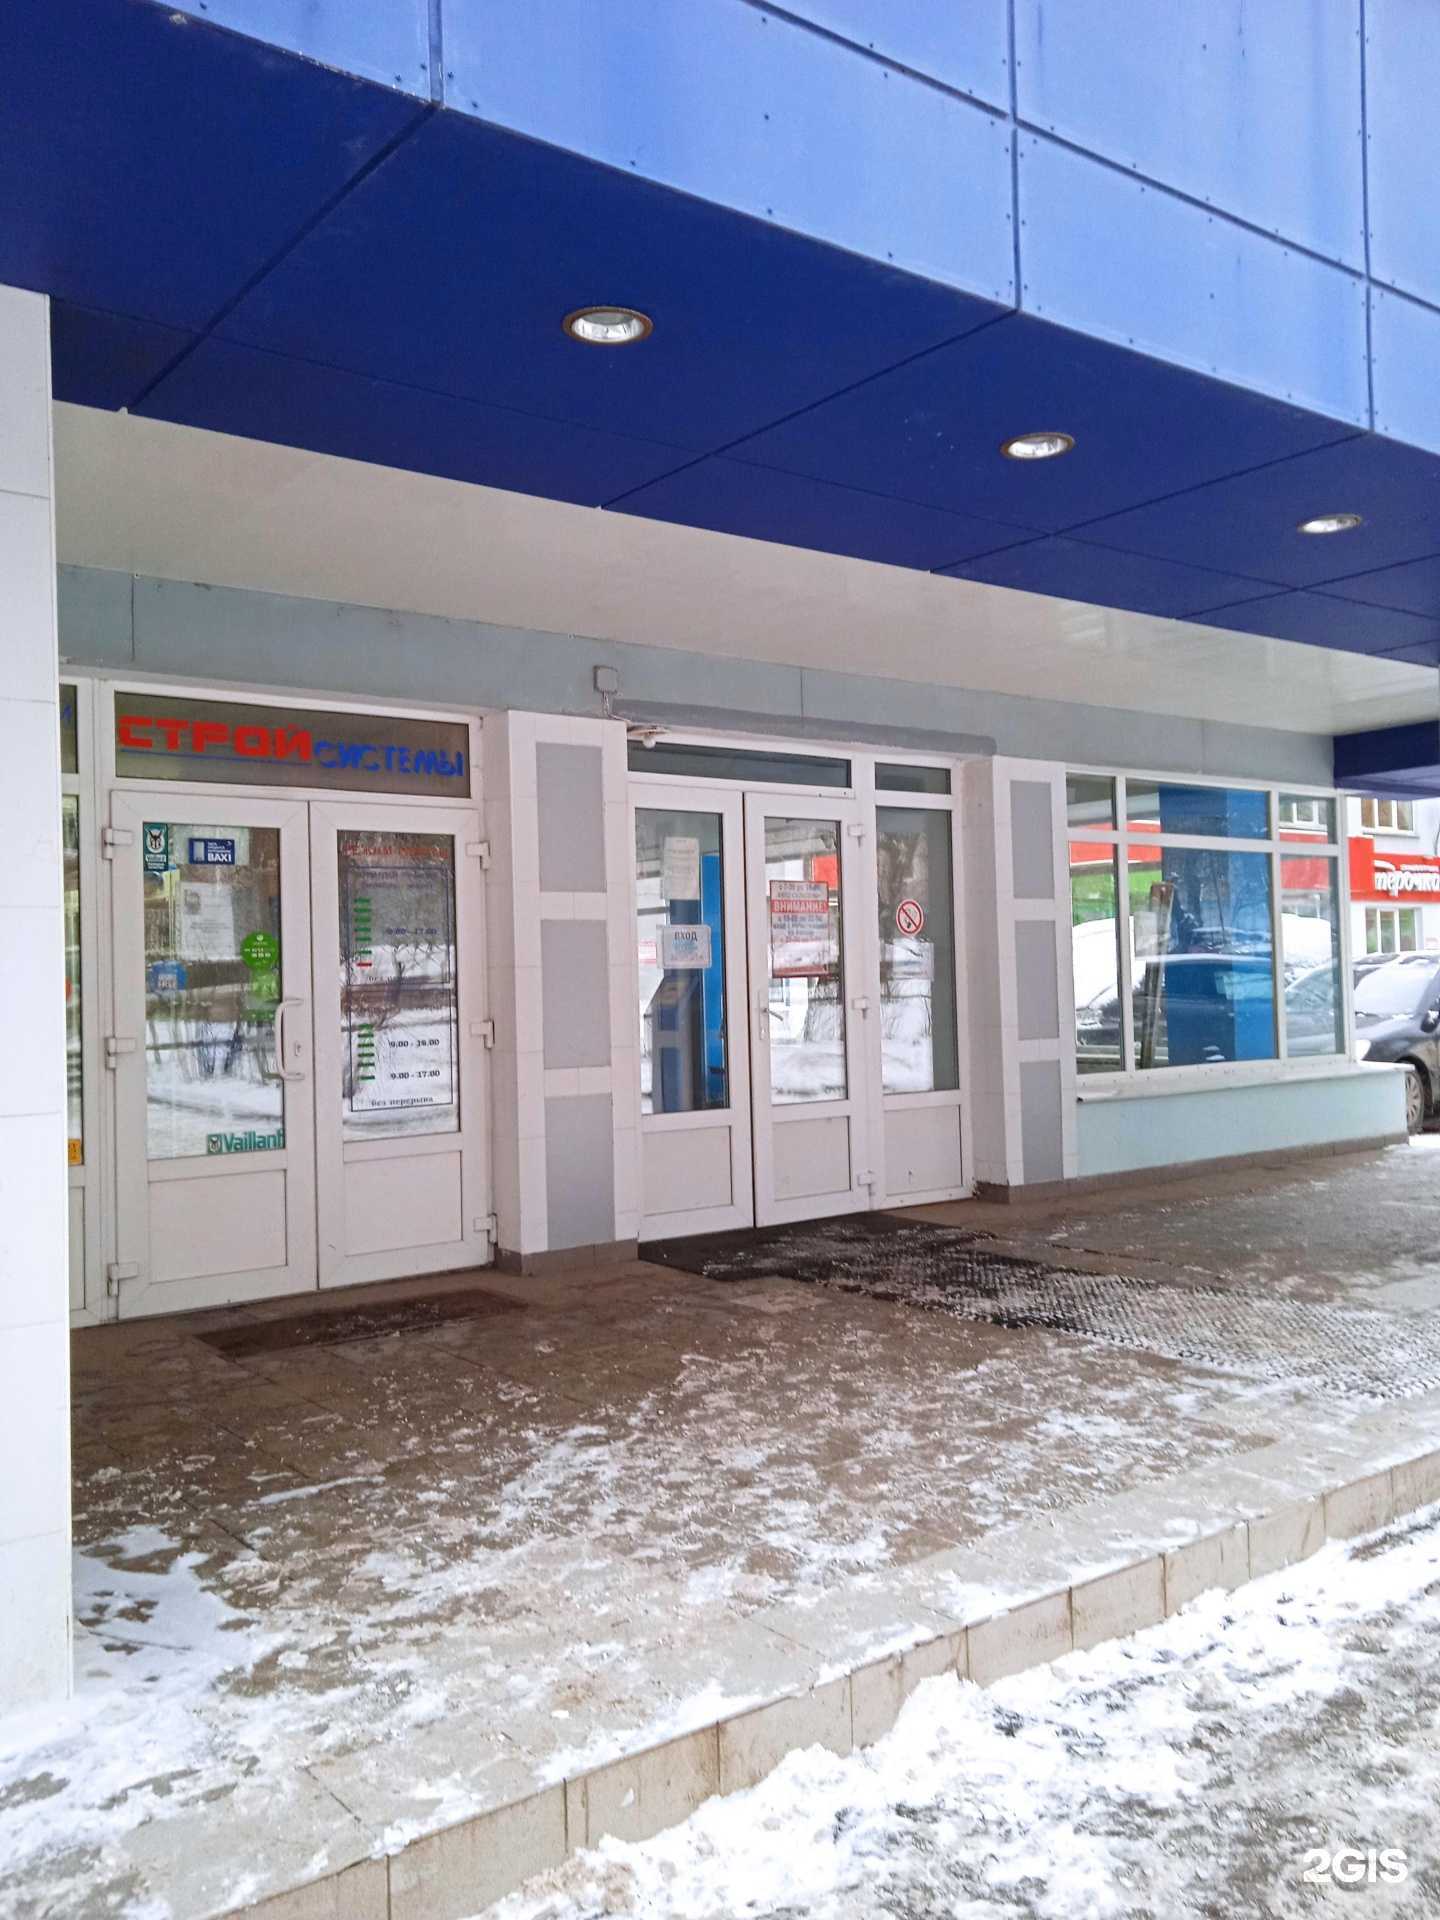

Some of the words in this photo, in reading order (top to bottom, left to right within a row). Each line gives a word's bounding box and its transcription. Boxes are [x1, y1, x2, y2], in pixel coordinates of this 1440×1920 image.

[118, 714, 312, 762] СТРОЙ
[314, 740, 464, 777] СИСТЕМЫ
[207, 853, 232, 862] BAXI
[674, 931, 698, 942] ВХОД
[390, 1072, 410, 1080] 9.00
[416, 1070, 440, 1079] 17.00
[223, 1128, 285, 1152] Vaillant
